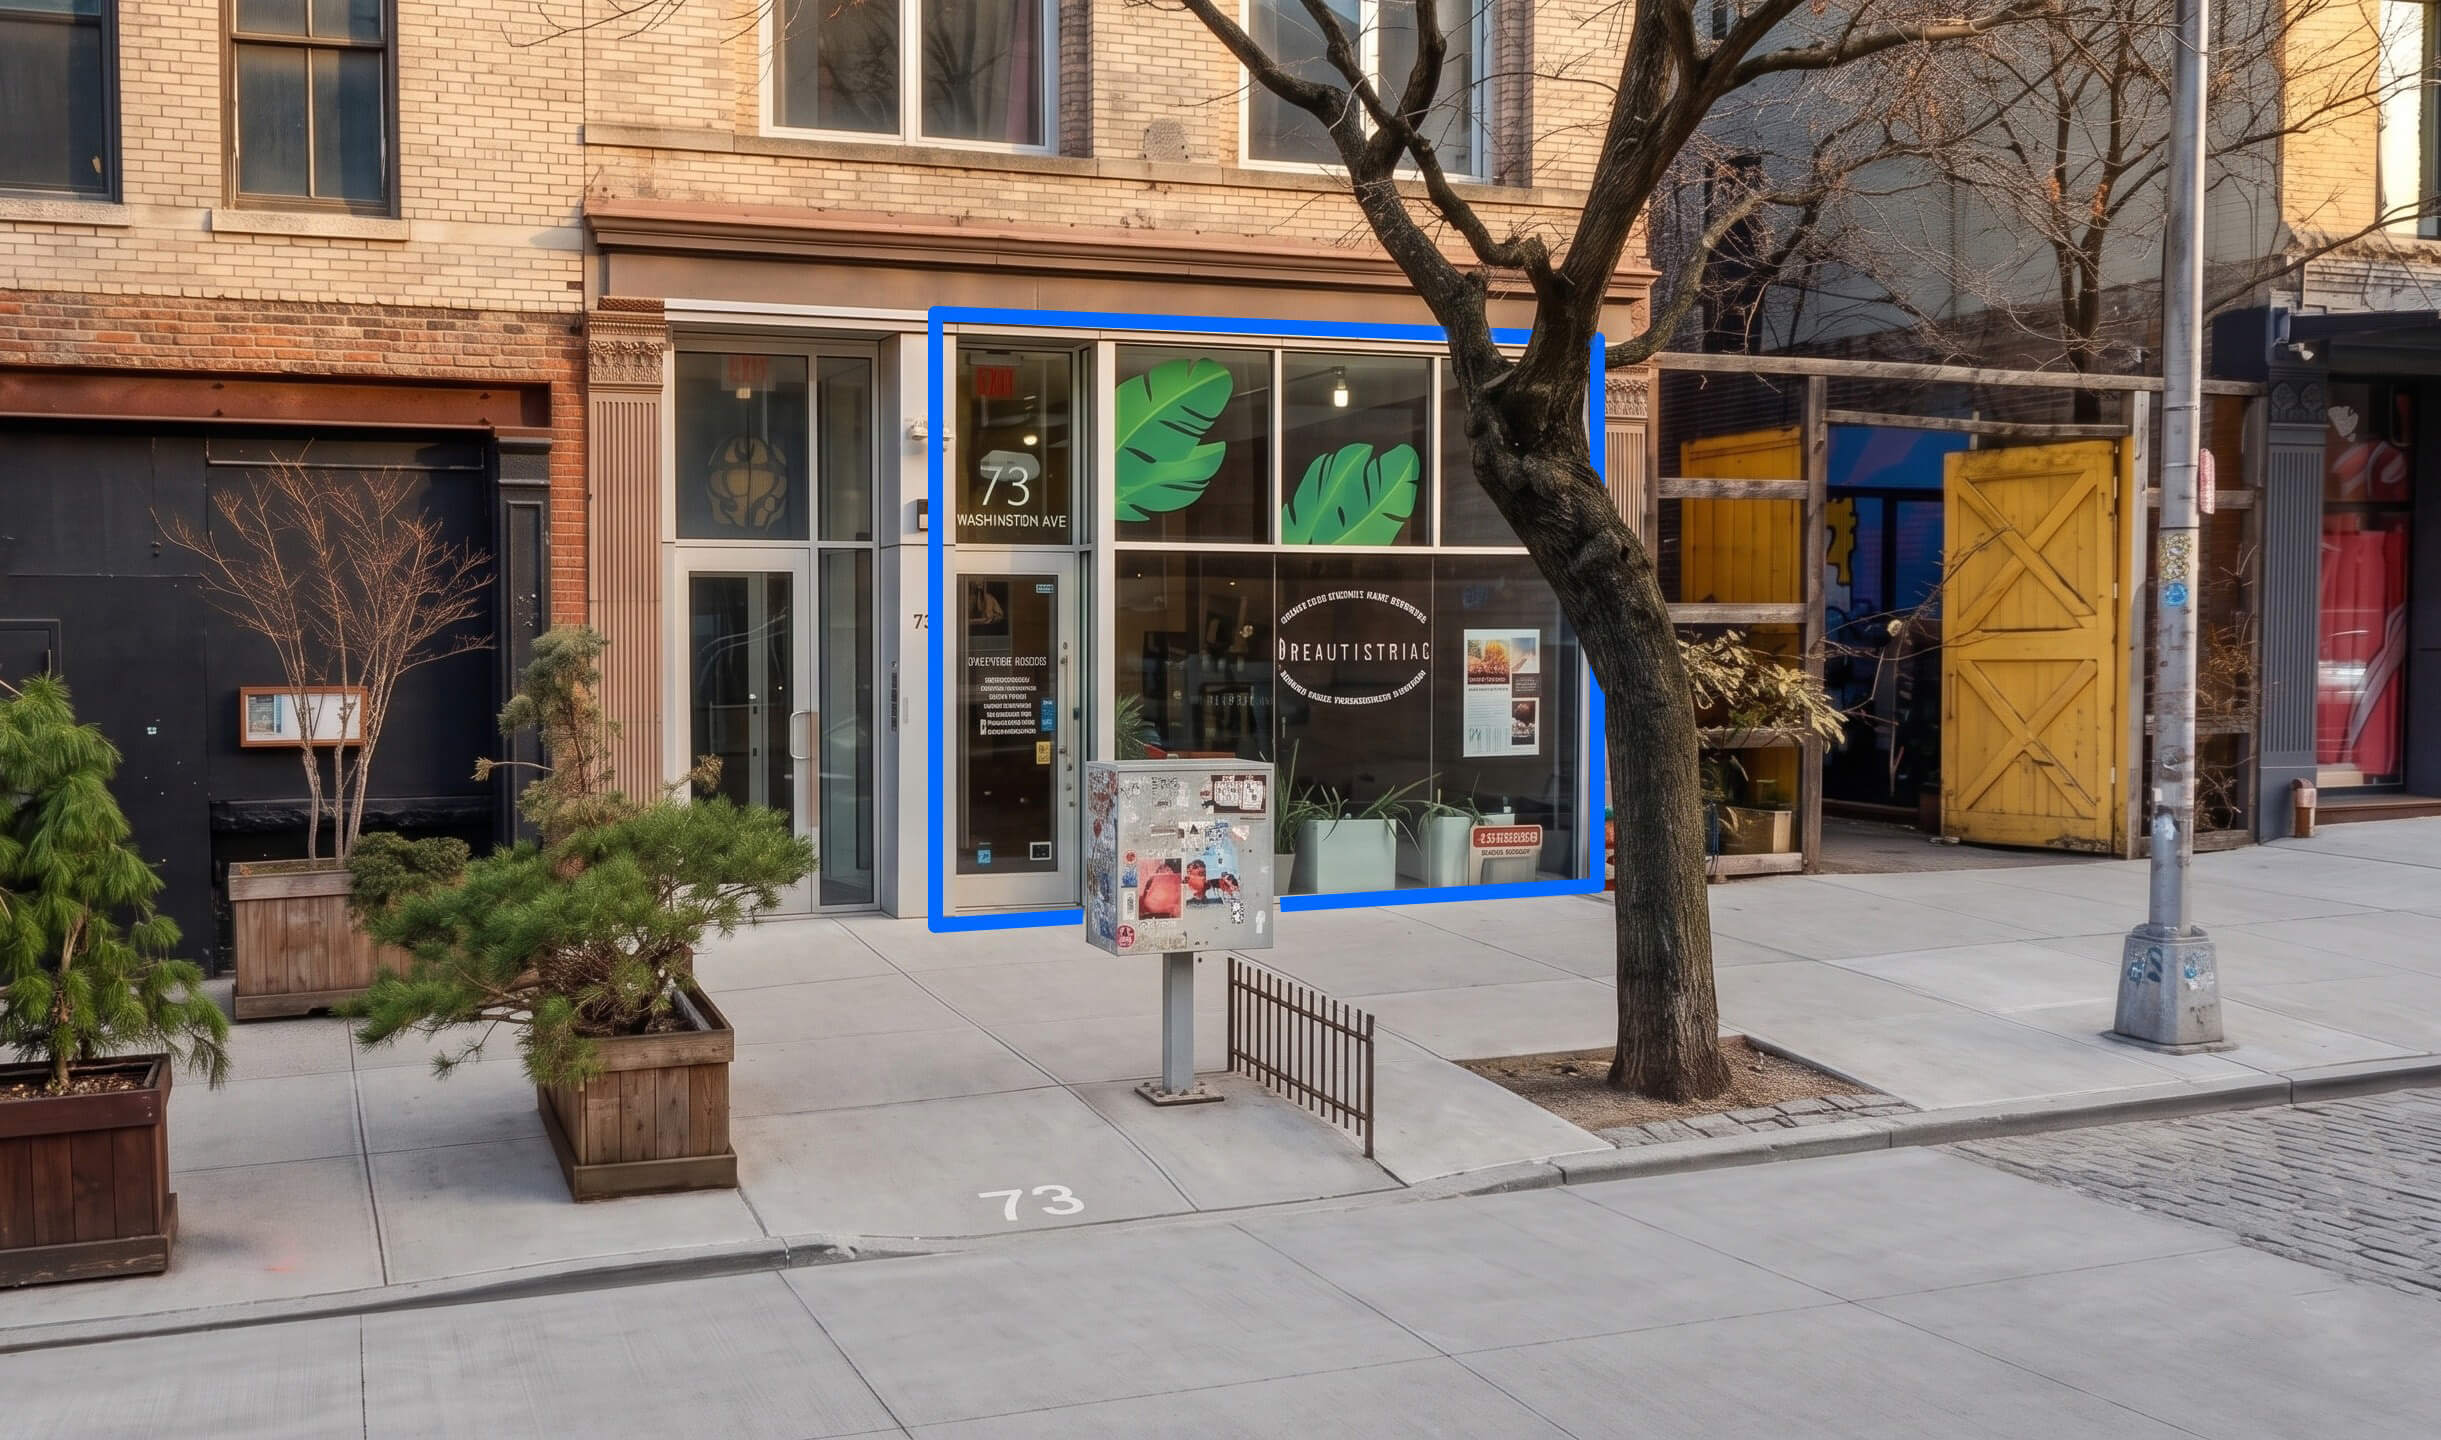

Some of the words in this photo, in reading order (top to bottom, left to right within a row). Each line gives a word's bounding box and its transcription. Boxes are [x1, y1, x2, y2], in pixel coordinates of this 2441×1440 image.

[980, 465, 1030, 506] 73
[1042, 515, 1067, 528] AVE
[977, 1184, 1085, 1221] 73
